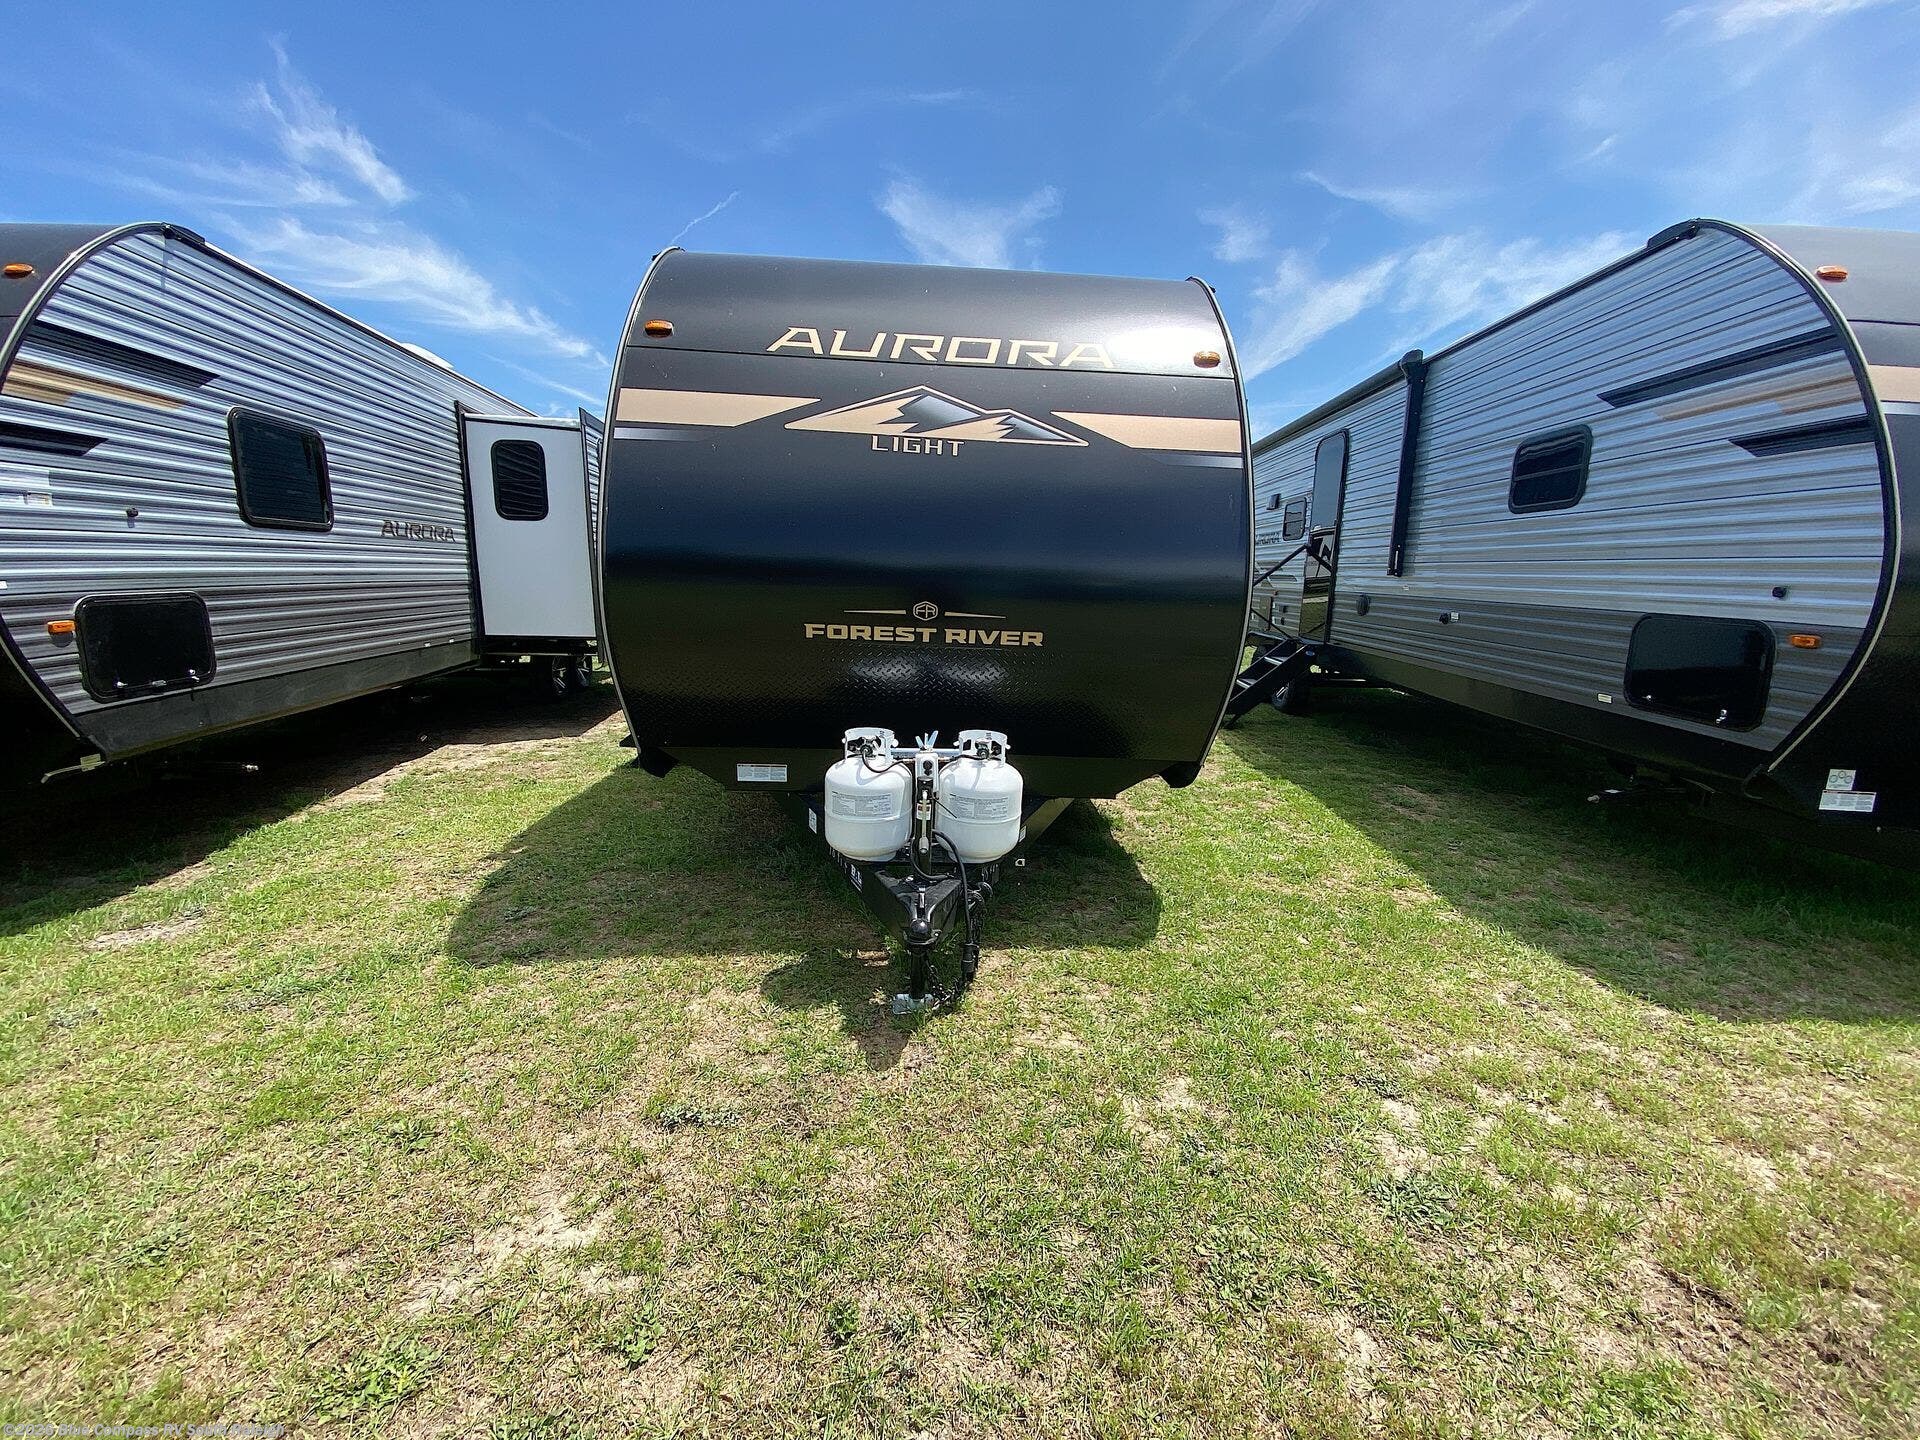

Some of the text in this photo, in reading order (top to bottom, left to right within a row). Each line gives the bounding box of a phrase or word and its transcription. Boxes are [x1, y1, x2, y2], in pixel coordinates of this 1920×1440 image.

[765, 326, 1114, 369] AURORA
[871, 434, 965, 457] LIGHT
[381, 520, 456, 543] AURORA
[803, 623, 1044, 647] FOREST RIVER
